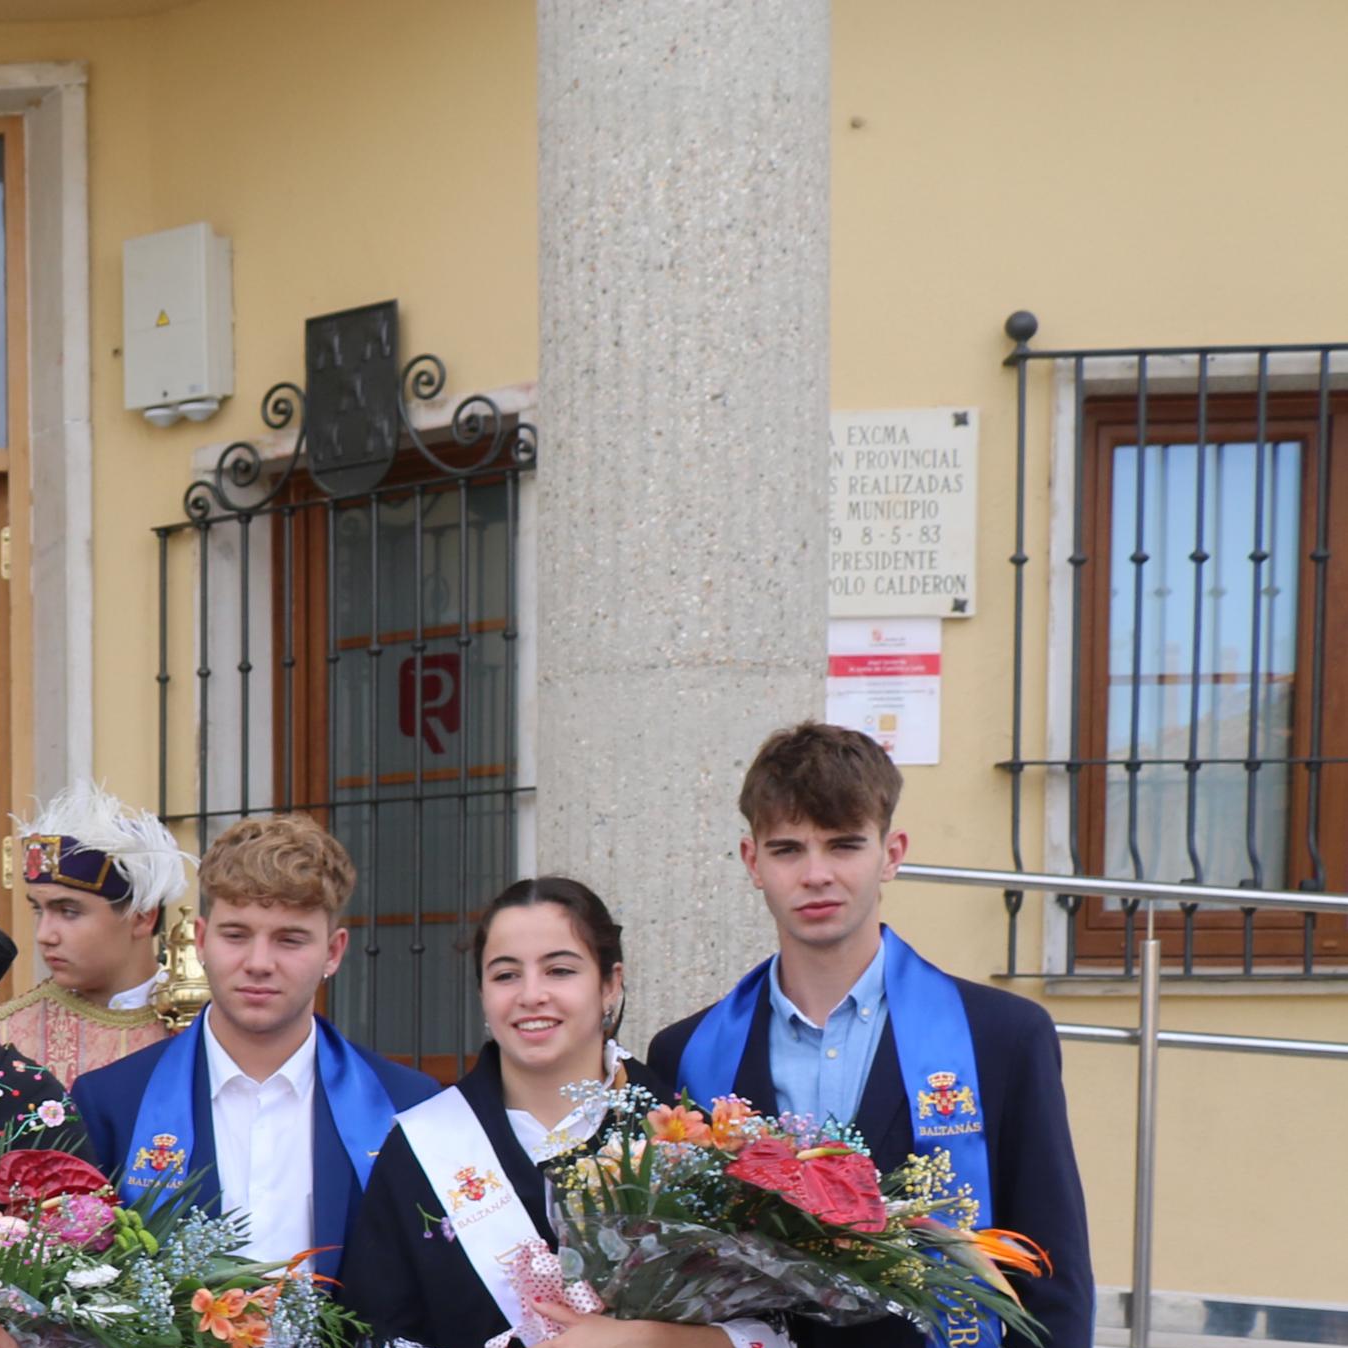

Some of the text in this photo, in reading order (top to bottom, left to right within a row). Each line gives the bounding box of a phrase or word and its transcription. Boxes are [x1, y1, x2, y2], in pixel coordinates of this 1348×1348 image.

[847, 425, 910, 446] EXCMA
[856, 448, 961, 470] PROVINCIAL
[848, 473, 964, 496] REALIZADAS
[847, 499, 939, 521] MUNICIPIO
[831, 550, 938, 572] PRESIDENTE
[874, 574, 967, 596] CALDERON
[918, 1120, 982, 1137] BALTANÁS
